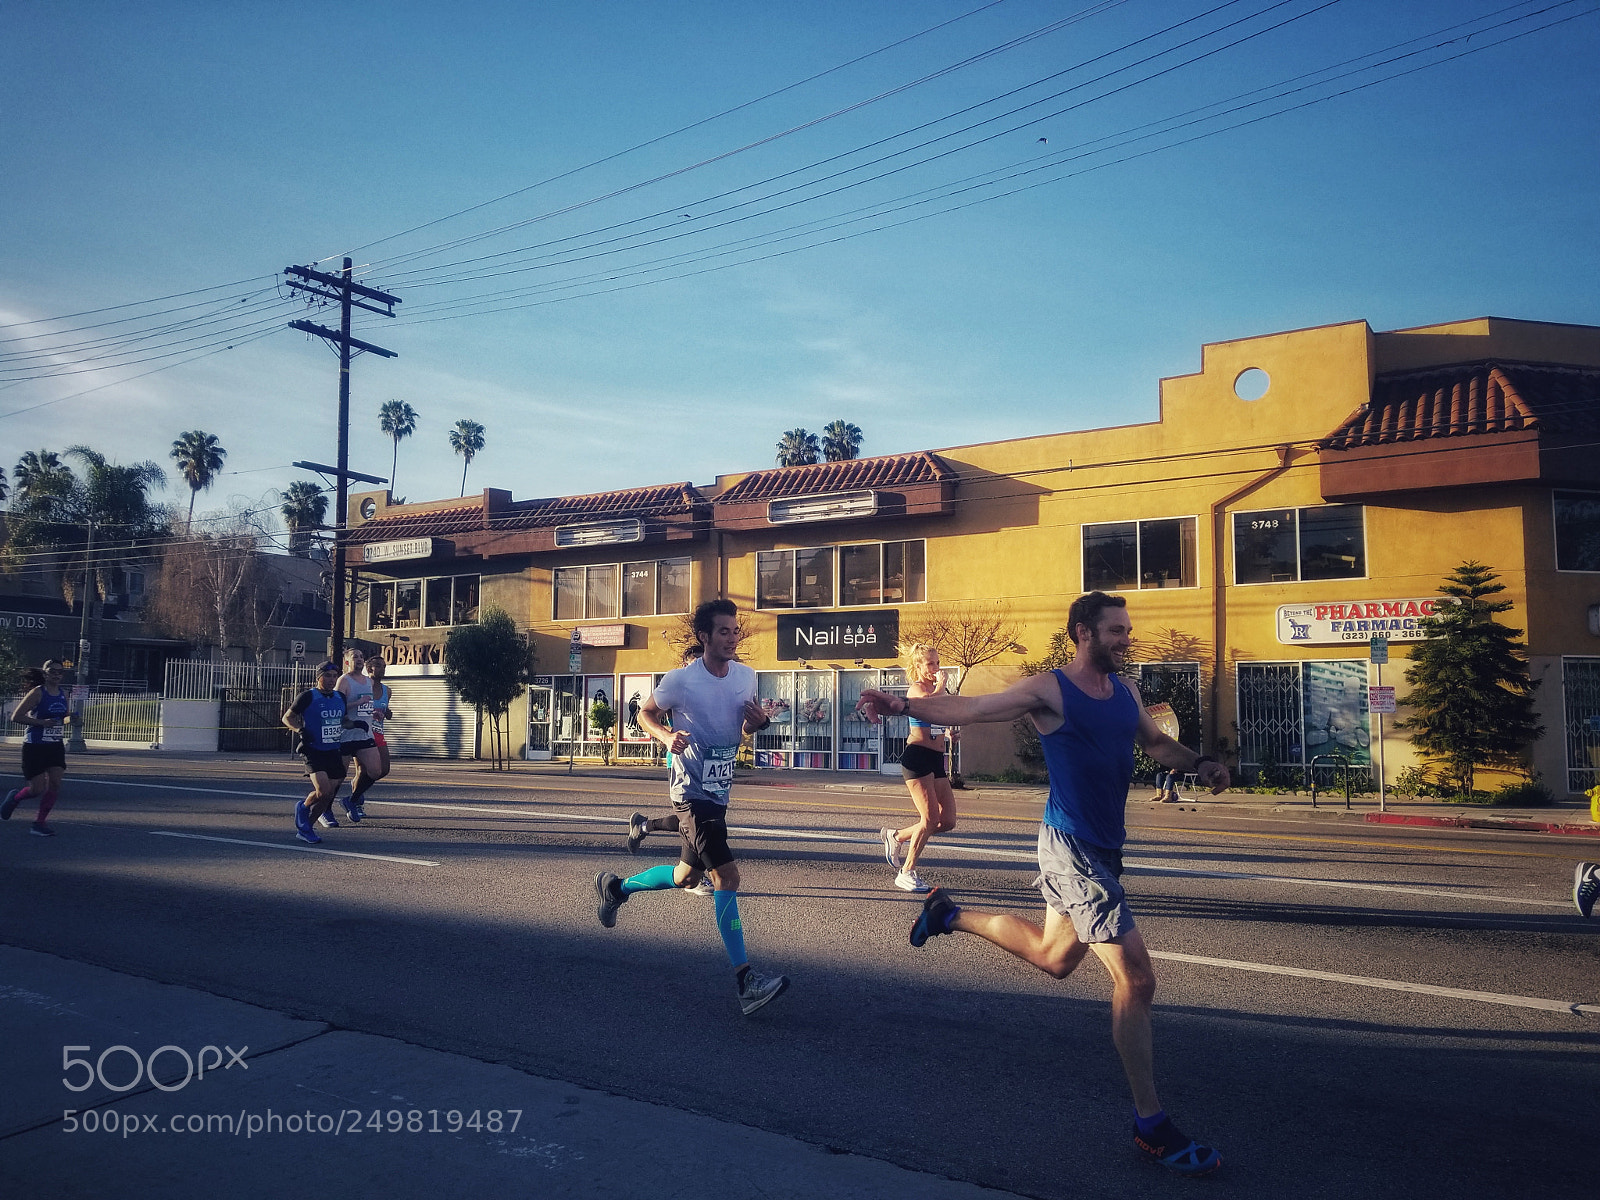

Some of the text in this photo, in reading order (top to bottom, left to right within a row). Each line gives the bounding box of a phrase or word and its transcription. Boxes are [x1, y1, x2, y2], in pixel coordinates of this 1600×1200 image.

[1251, 519, 1279, 529] 3748
[392, 543, 413, 557] SUNSET
[631, 570, 649, 578] 3744
[1303, 608, 1313, 616] THE
[16, 615, 48, 629] D.D.S.
[795, 625, 877, 647] Nail spa
[1341, 632, 1368, 640] (323)
[1372, 631, 1391, 639] 660
